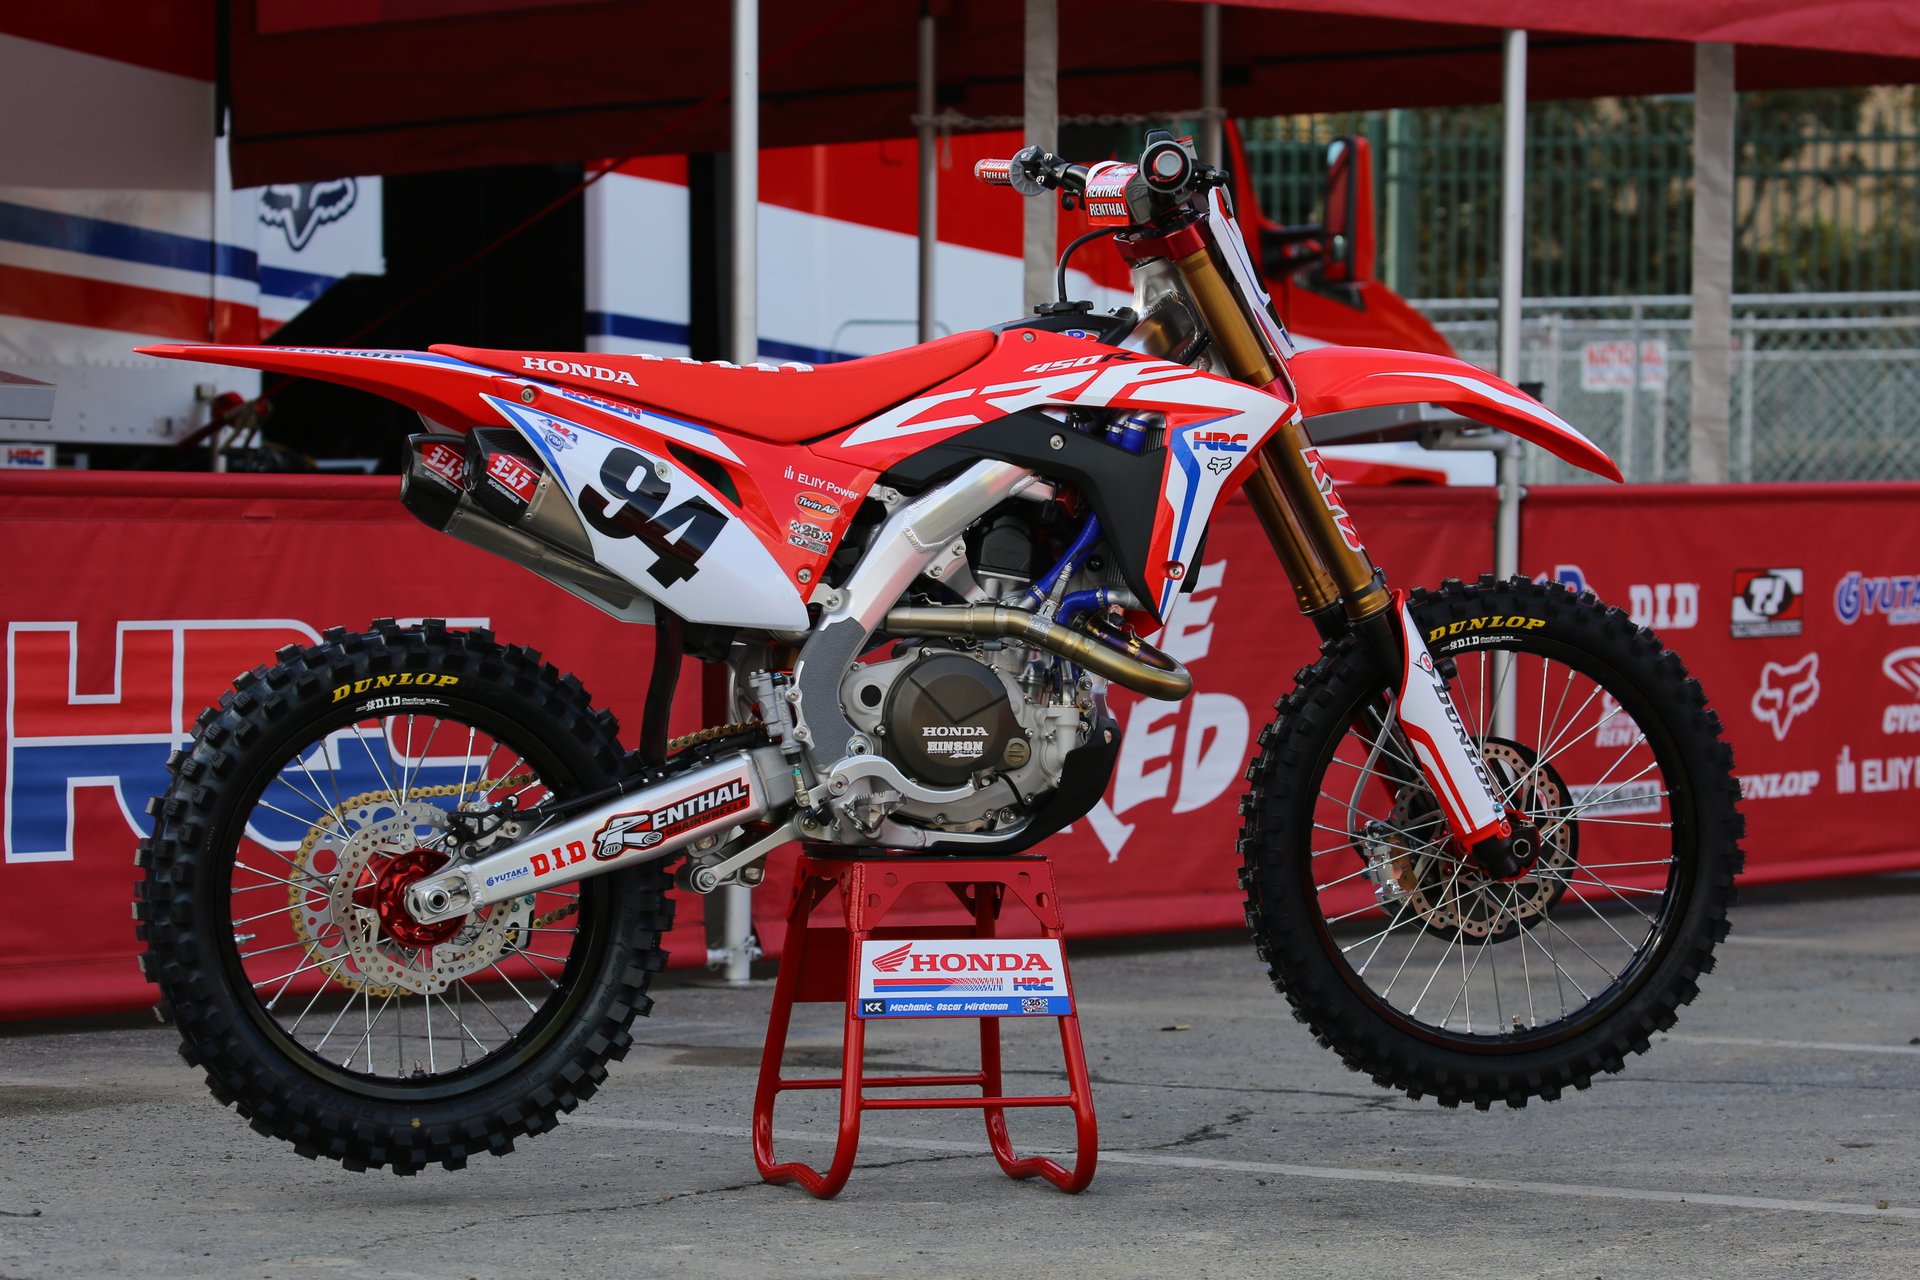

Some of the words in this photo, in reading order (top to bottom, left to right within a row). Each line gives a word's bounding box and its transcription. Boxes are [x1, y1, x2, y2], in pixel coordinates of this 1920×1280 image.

[1086, 184, 1123, 198] RENTHAL
[1089, 202, 1127, 217] RENTHAL
[522, 356, 640, 387] HONDA
[1023, 352, 1139, 373] 450R
[561, 387, 643, 421] ROCZEN
[538, 417, 579, 443] AMA
[1193, 431, 1248, 453] HRC
[7, 447, 45, 466] HRC
[826, 481, 860, 500] Power
[799, 496, 822, 511] Twin
[821, 504, 839, 516] Air
[578, 447, 729, 589] 94
[801, 524, 821, 540] 25
[1428, 615, 1546, 644] DUNLOP
[331, 672, 460, 704] DUNLOP
[922, 727, 990, 737] HONDA
[927, 741, 984, 752] HINSON
[664, 800, 748, 837] CHAINWHEELS
[494, 866, 529, 882] YUTAKA
[530, 840, 587, 877] D.I.D
[910, 953, 1053, 972] HONDA
[1013, 977, 1054, 991] HRC
[889, 1002, 934, 1012] Mechanic:
[936, 1002, 962, 1011] Oscar
[964, 1002, 1009, 1011] Wirdeman
